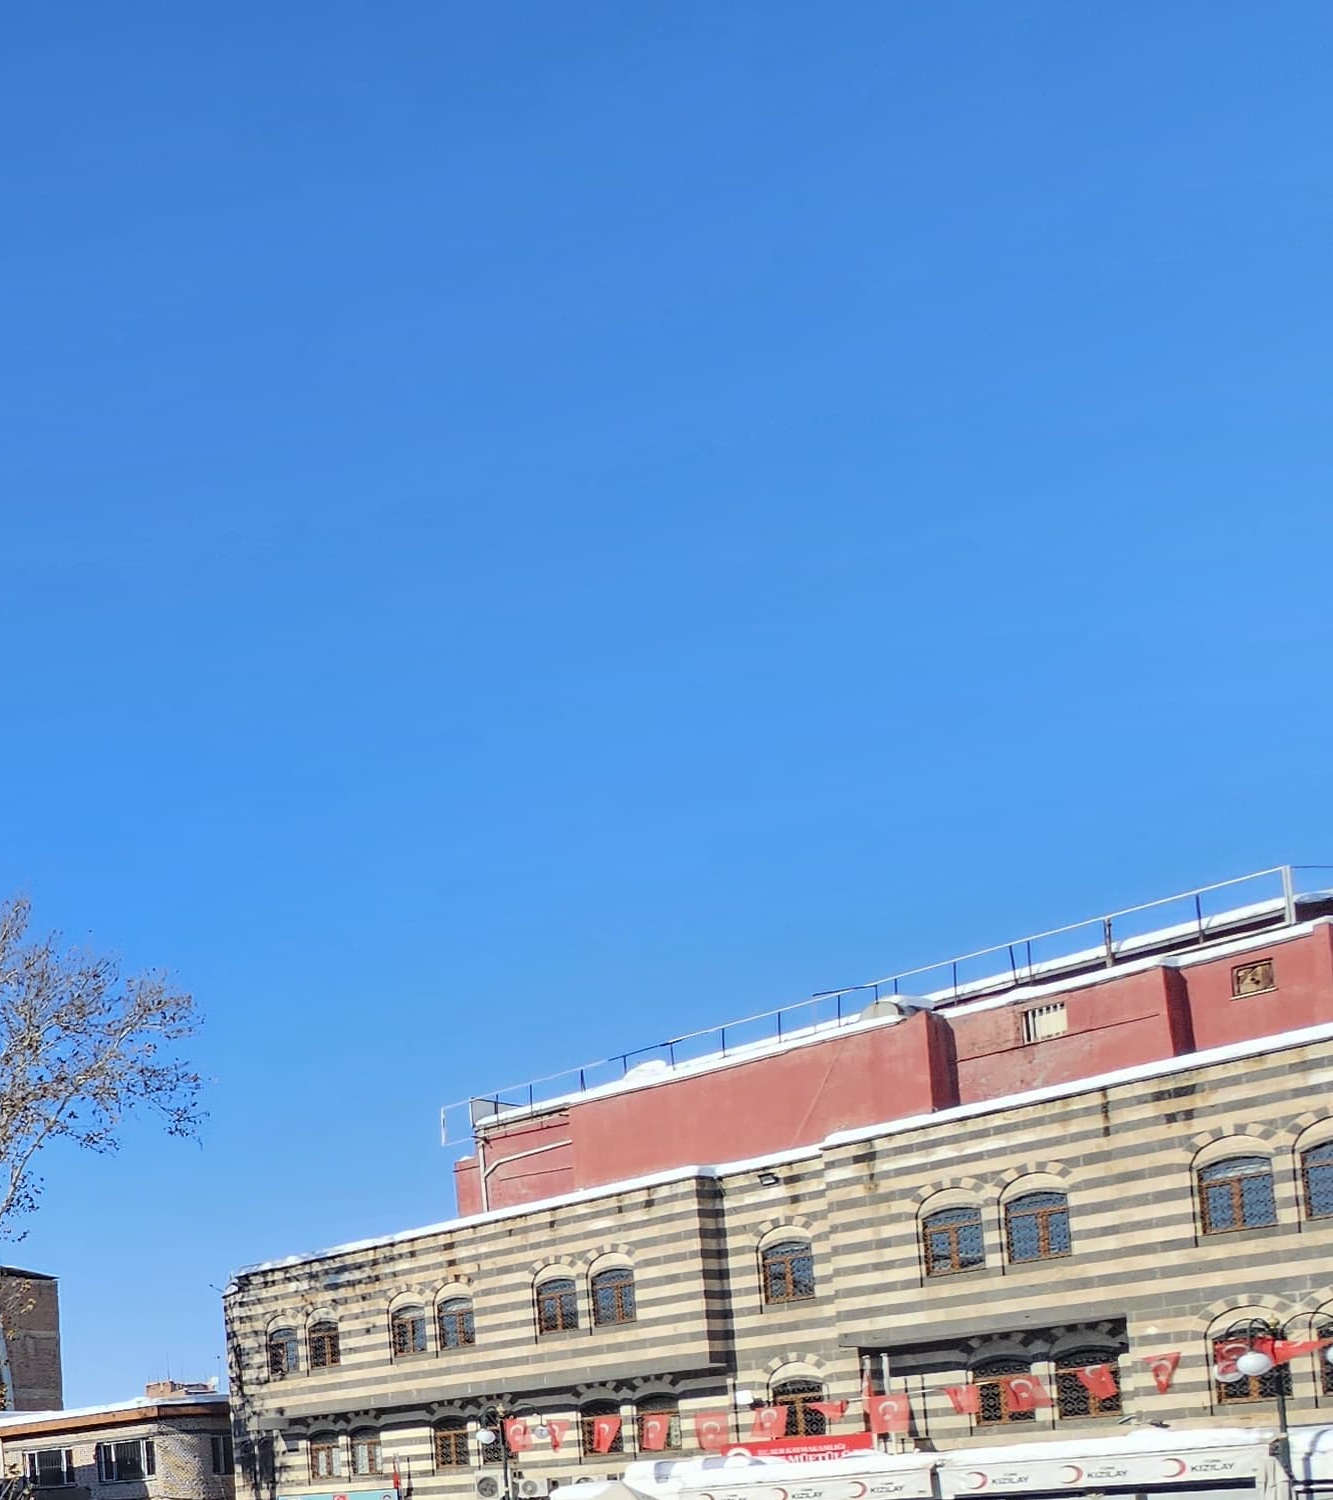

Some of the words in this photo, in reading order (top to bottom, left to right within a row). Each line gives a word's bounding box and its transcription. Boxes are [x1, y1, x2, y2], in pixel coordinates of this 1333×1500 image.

[1191, 1462, 1235, 1473] KIZILAY
[1087, 1468, 1128, 1479] KIZILAY
[991, 1476, 1029, 1485] KIZILAY
